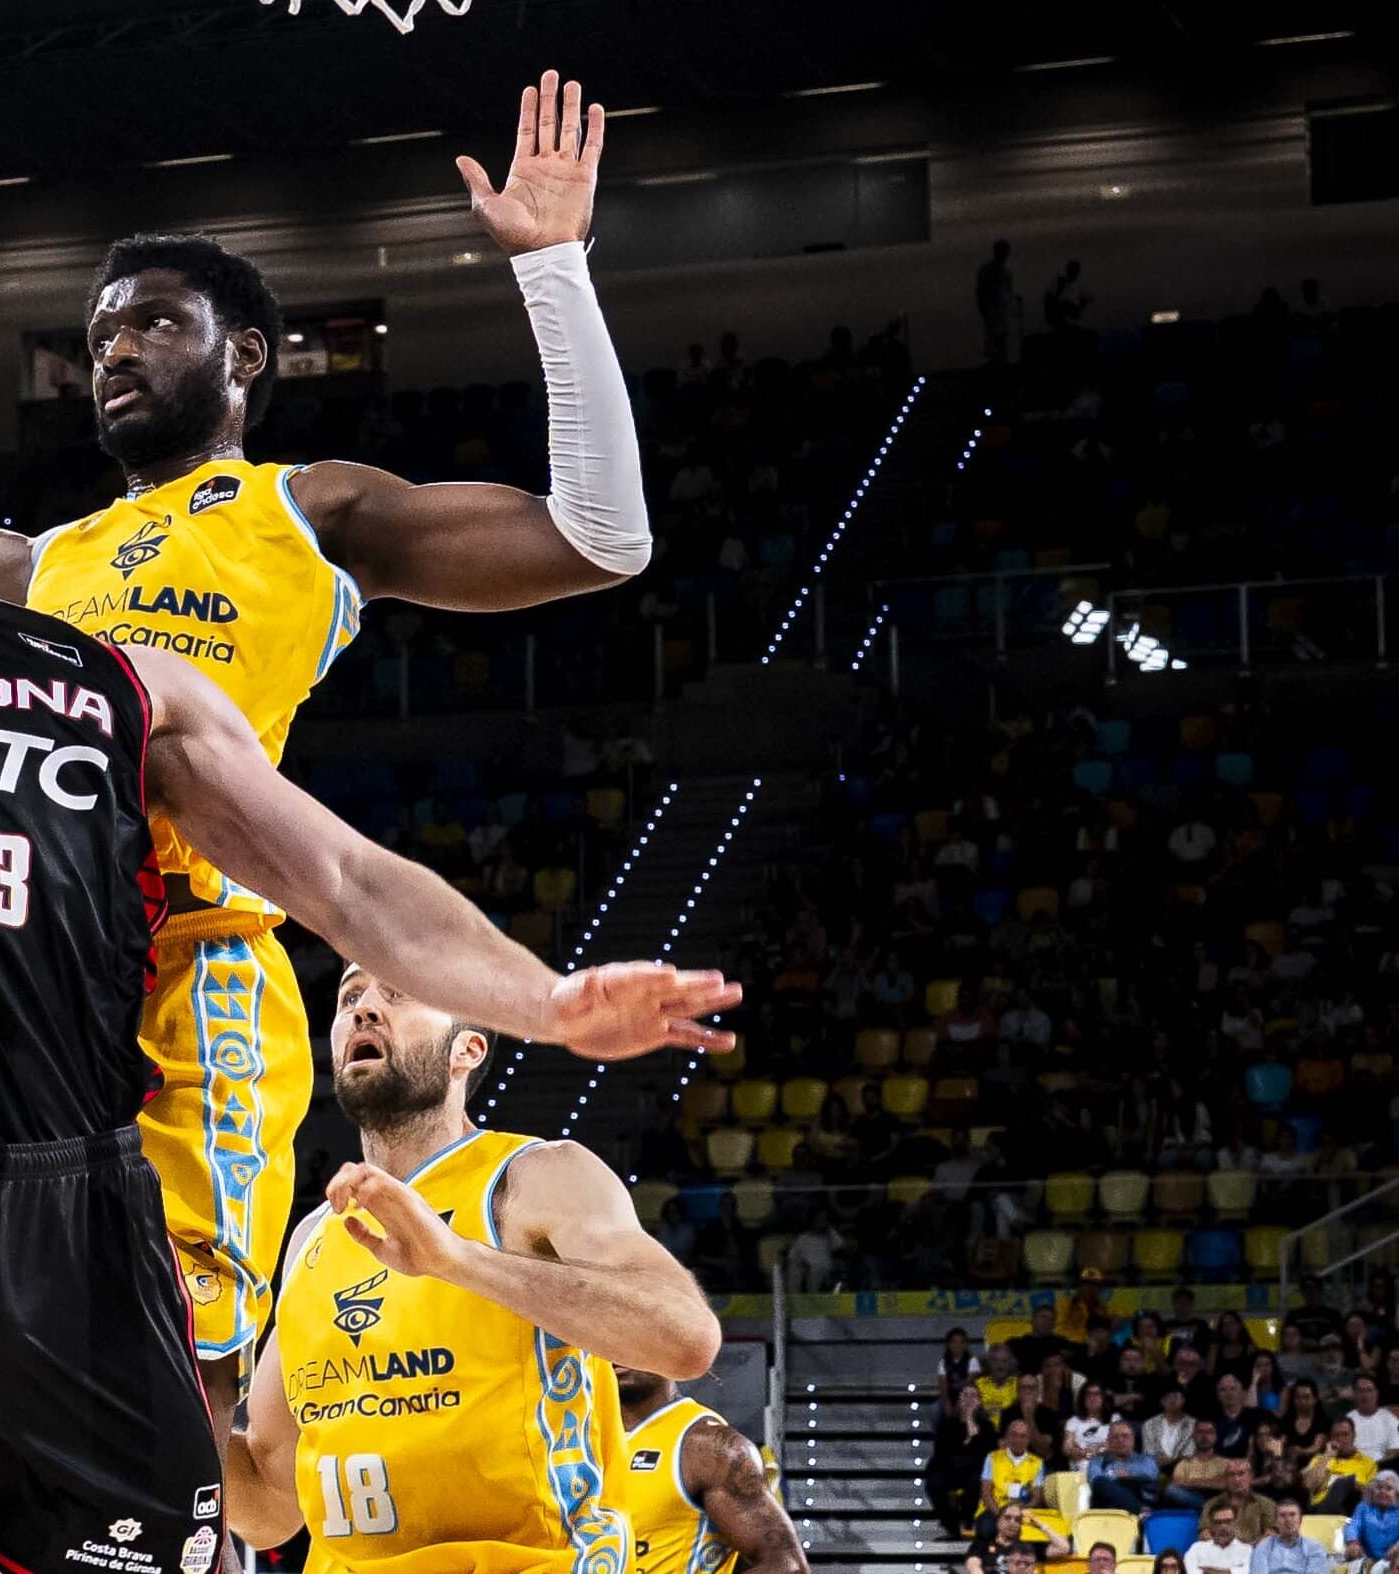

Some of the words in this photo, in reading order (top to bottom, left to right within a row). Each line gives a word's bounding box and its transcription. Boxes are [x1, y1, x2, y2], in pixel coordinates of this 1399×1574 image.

[53, 586, 238, 623] EAMLAND
[90, 623, 235, 664] nCanaria
[300, 1387, 460, 1424] GranCanaria
[316, 1453, 399, 1538] 18
[65, 1549, 108, 1568] Pirineu
[108, 1559, 124, 1571] de
[124, 1561, 163, 1574] Girona
[82, 1539, 117, 1557] Costa
[118, 1547, 154, 1563] Brava
